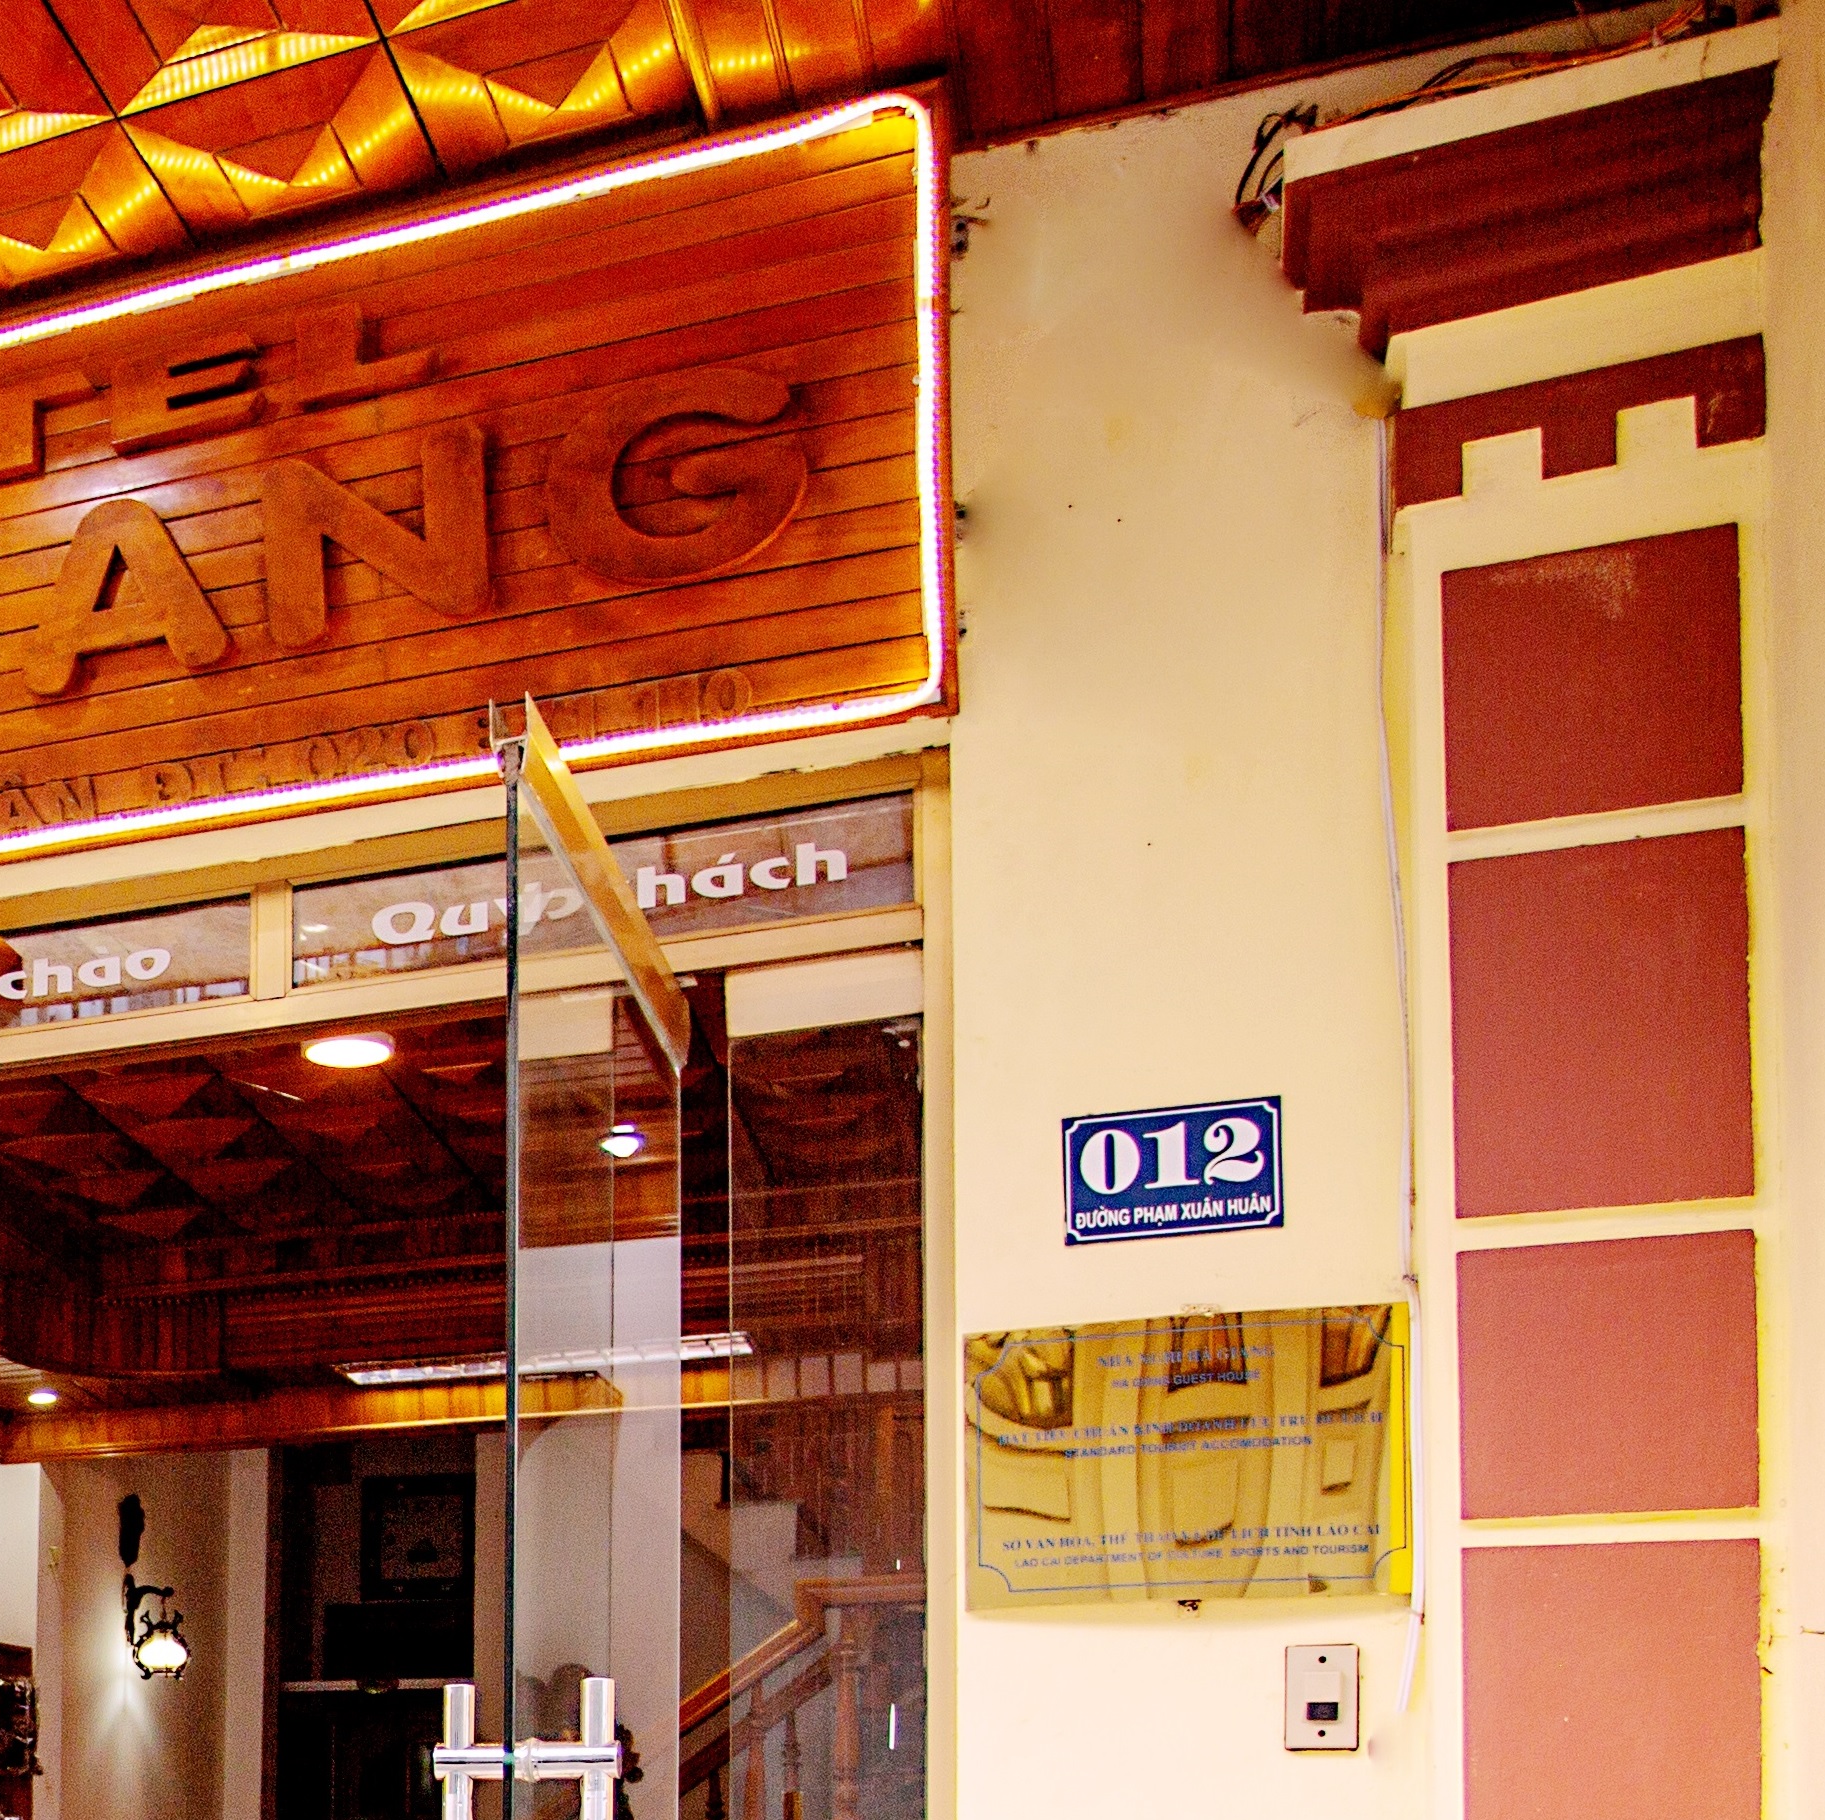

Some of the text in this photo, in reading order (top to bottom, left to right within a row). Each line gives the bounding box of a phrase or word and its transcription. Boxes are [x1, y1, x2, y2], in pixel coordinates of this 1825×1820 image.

[628, 841, 850, 911] hách
[1079, 1117, 1266, 1195] 012
[1075, 1191, 1272, 1230] ĐƯỜNG PHẠM XUÂN HUÂN
[1174, 1372, 1215, 1385] GUEST
[1217, 1370, 1262, 1384] HOUSE
